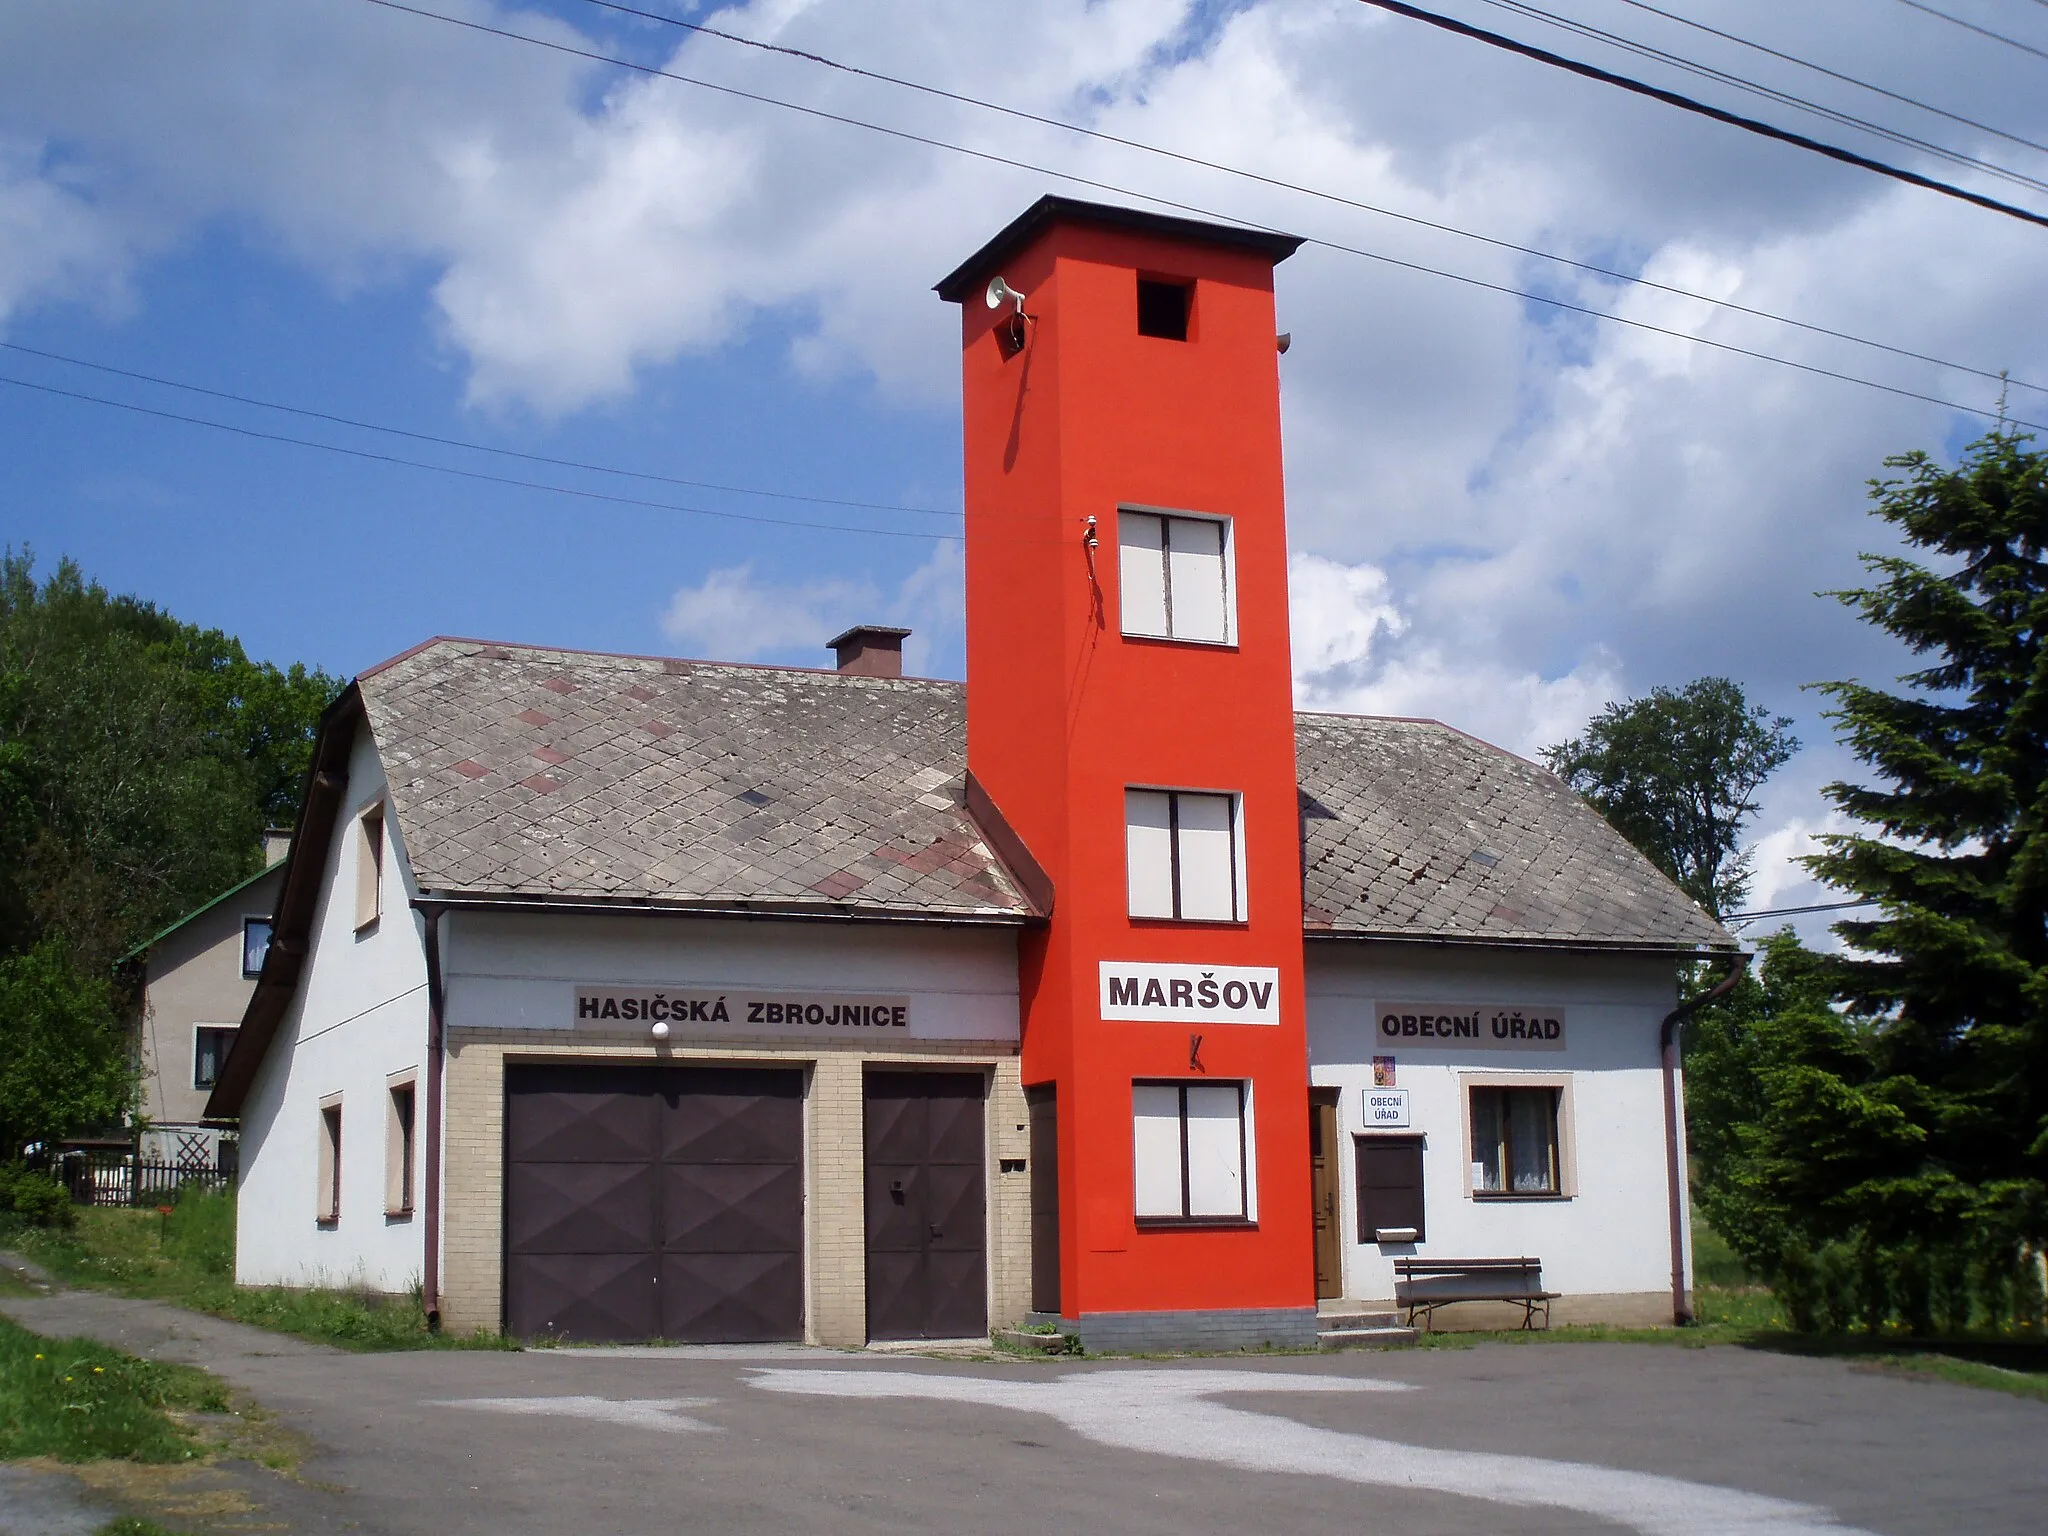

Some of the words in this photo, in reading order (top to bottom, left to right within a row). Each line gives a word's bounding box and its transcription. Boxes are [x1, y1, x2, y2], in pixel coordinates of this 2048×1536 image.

[1108, 972, 1273, 1010] MARŠOV
[579, 994, 730, 1022] HASIČSKÁ
[747, 1002, 906, 1027] ZBROJNICE
[1381, 1011, 1480, 1038] OBECNÍ
[1491, 1012, 1561, 1040] ÚŘAD
[1370, 1095, 1402, 1106] OBECNÍ
[1375, 1108, 1399, 1119] ÚŘAD
